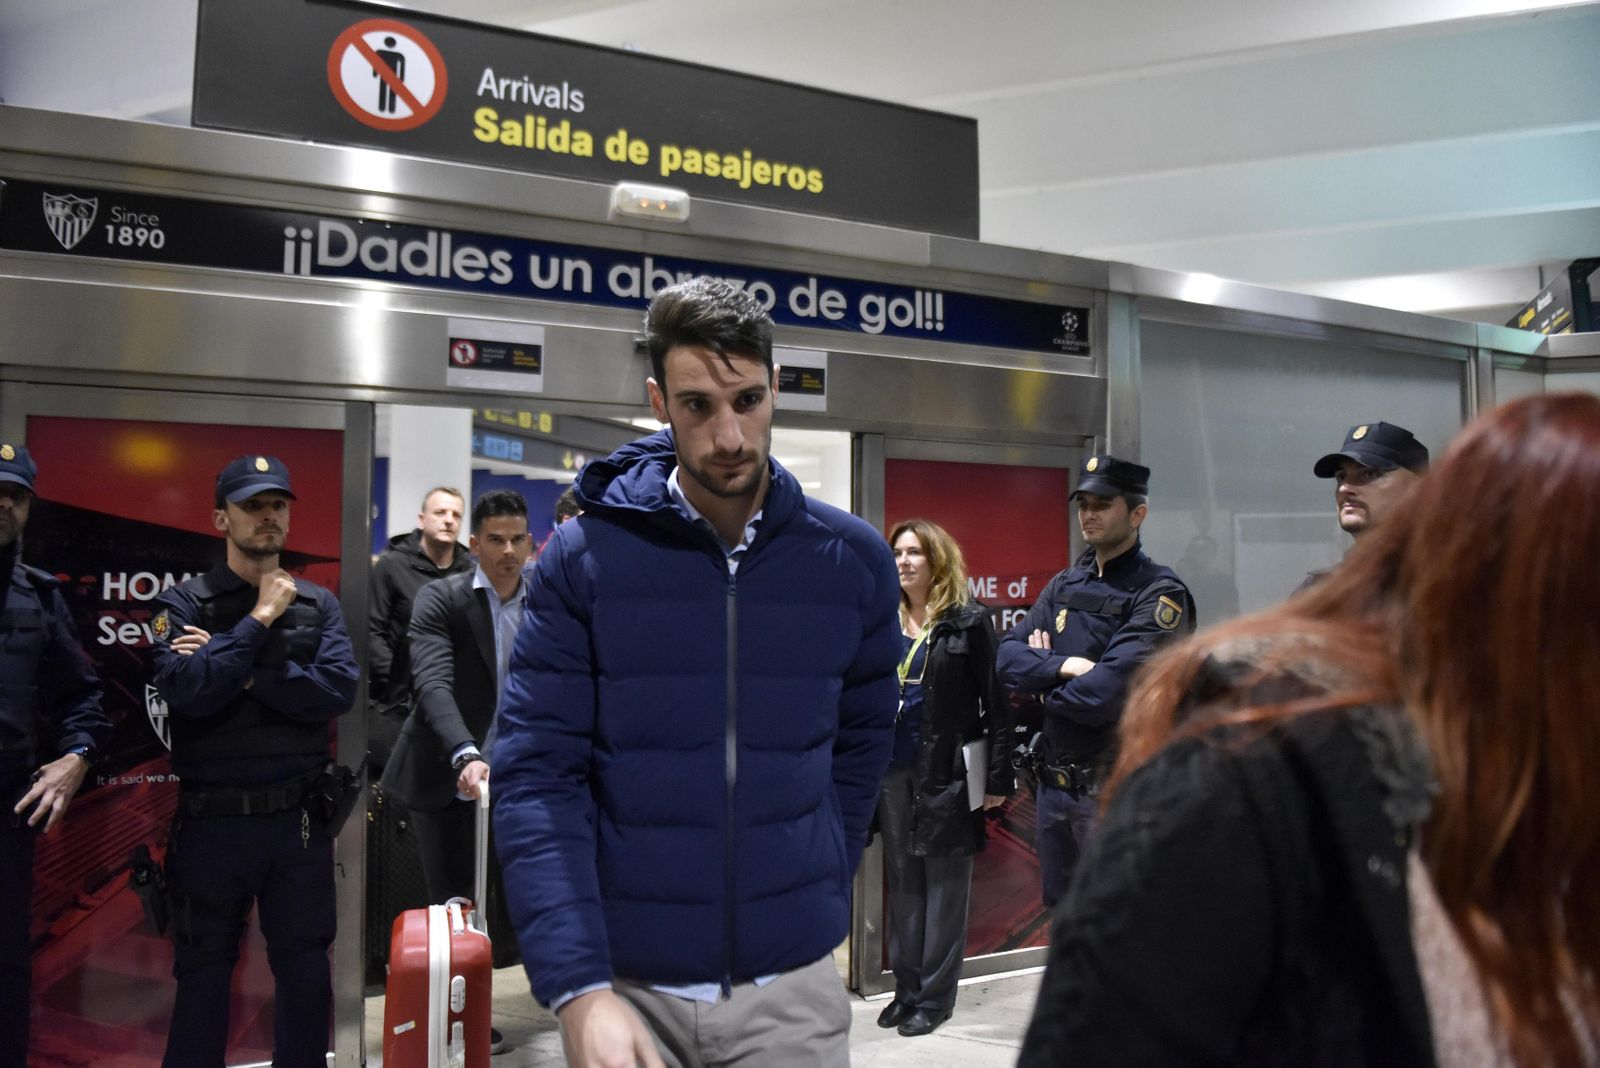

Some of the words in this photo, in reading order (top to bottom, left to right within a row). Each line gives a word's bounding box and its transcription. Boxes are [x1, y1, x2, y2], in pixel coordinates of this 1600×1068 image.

[476, 67, 585, 114] Arrivals
[473, 106, 594, 159] Salida
[604, 129, 650, 166] de
[660, 144, 824, 195] pasajeros
[110, 206, 160, 229] Since
[105, 224, 166, 250] 1890
[528, 253, 593, 294] un
[788, 276, 848, 322] de
[859, 291, 945, 334] gol!!
[103, 571, 206, 601] HOM
[1007, 576, 1028, 599] of
[97, 774, 105, 786] It
[109, 774, 117, 785] is
[121, 772, 144, 785] said
[146, 773, 165, 783] we
